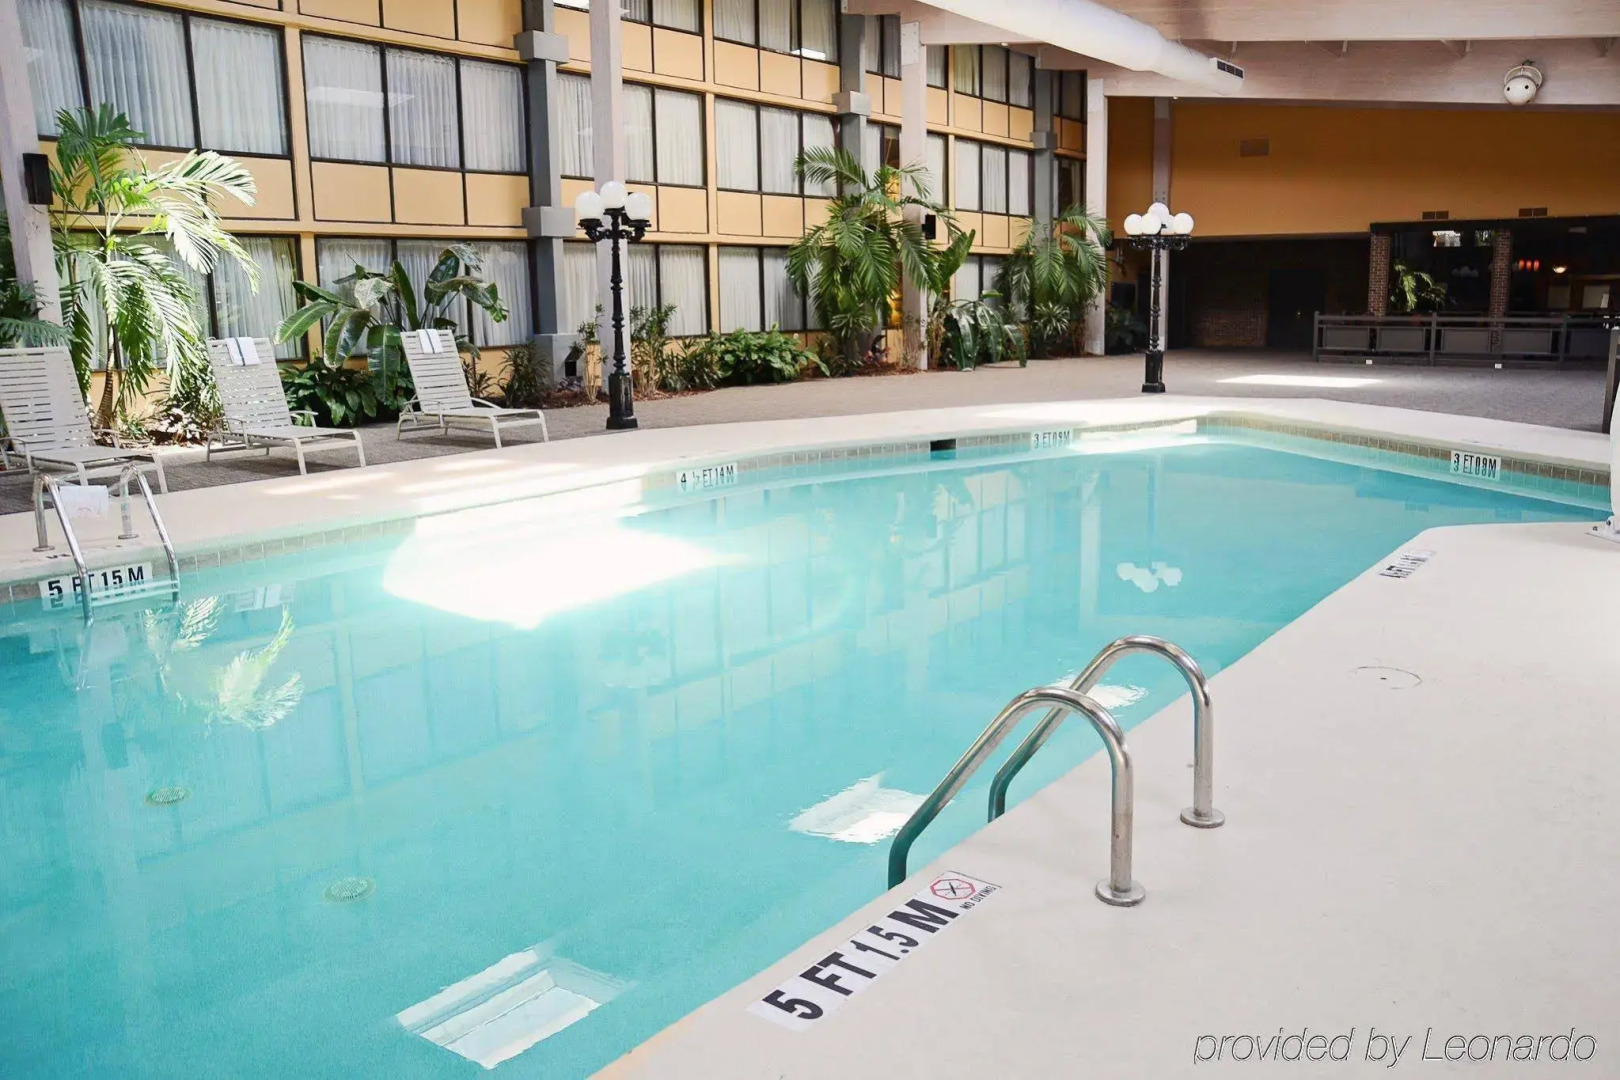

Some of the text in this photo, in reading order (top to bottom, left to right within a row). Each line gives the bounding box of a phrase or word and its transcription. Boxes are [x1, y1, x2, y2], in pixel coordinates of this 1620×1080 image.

[680, 472, 687, 483] 4
[47, 579, 63, 595] 5
[127, 565, 145, 583] M
[959, 885, 997, 910] NO DIVING
[762, 898, 960, 1020] 5 FT 1.5 M
